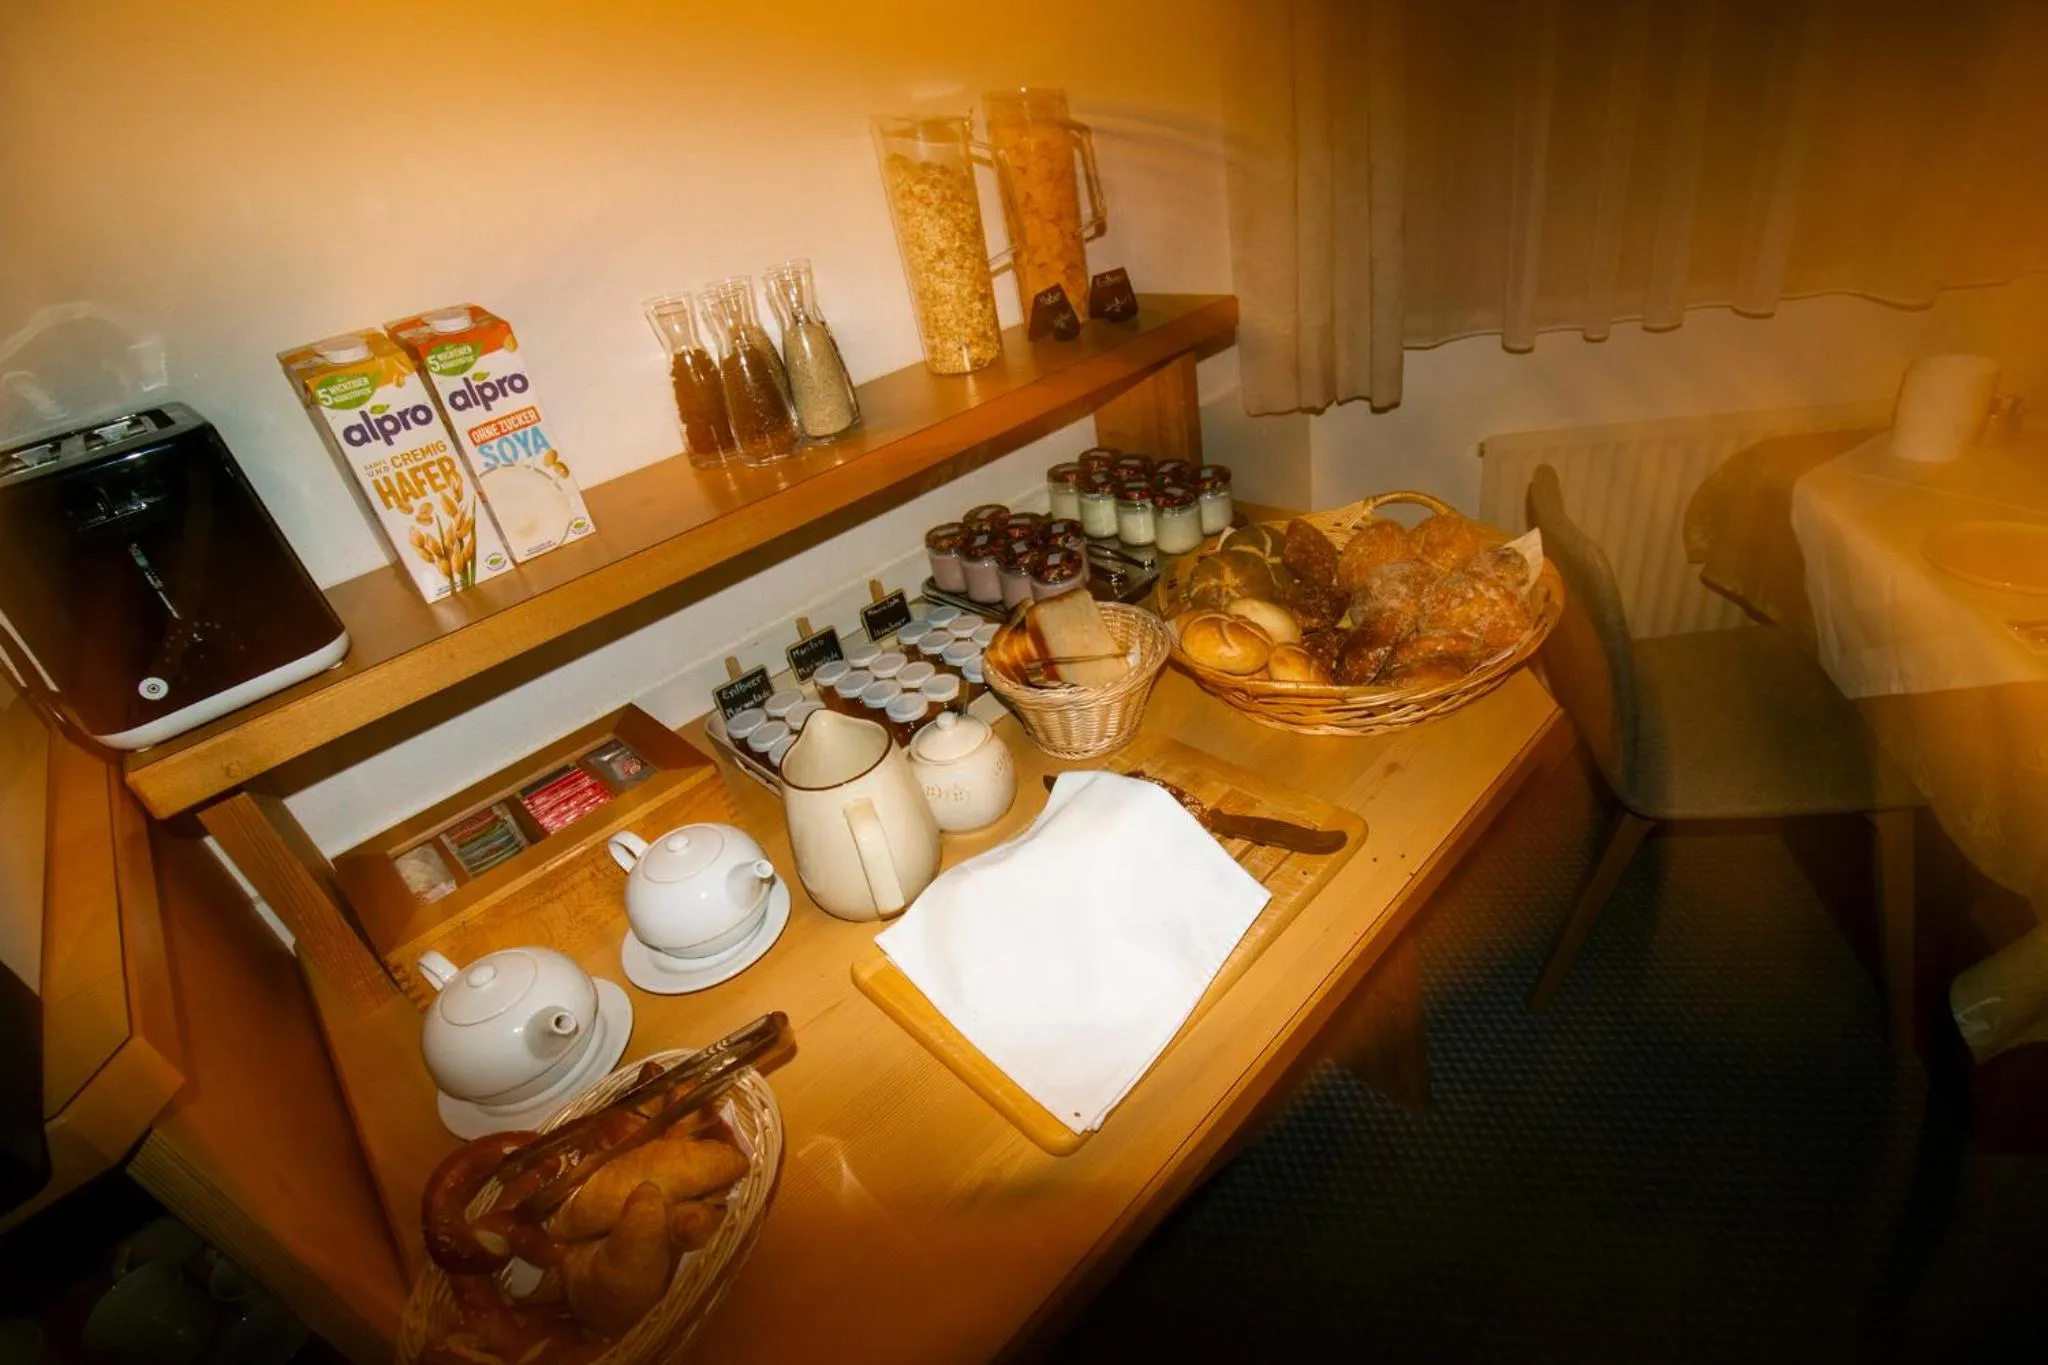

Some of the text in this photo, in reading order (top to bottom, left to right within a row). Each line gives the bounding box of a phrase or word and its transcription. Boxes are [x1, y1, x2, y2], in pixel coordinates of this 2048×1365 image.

[428, 355, 441, 372] 5
[317, 388, 333, 406] 5
[448, 373, 529, 412] alpro
[343, 404, 433, 447] alpro
[471, 410, 537, 444] OHNE ZUCKER
[390, 439, 447, 468] CREMIG
[478, 426, 552, 468] SOYA
[372, 455, 459, 510] HAFER
